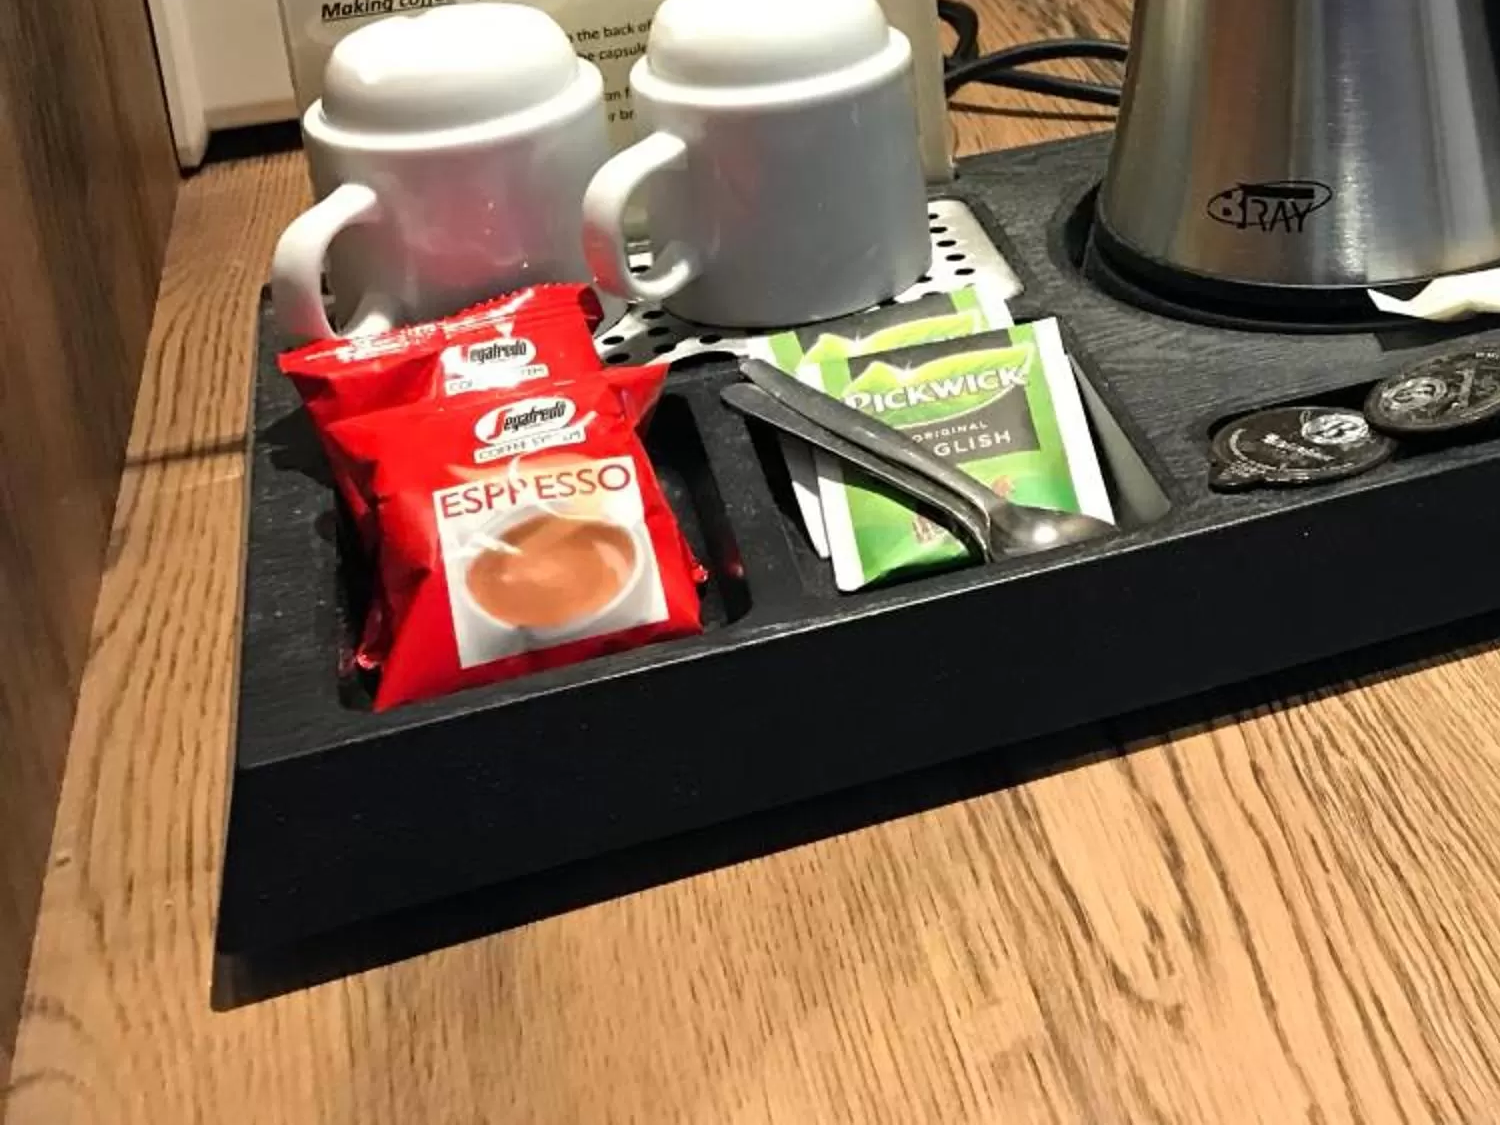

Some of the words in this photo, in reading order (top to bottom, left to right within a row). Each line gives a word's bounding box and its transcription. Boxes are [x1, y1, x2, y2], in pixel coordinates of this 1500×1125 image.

[576, 27, 600, 43] the
[603, 23, 635, 38] back
[844, 365, 1026, 412] PICKWICK
[487, 400, 567, 441] Segafredo
[911, 420, 989, 444] ORIGINAL
[933, 429, 1012, 457] GLISH
